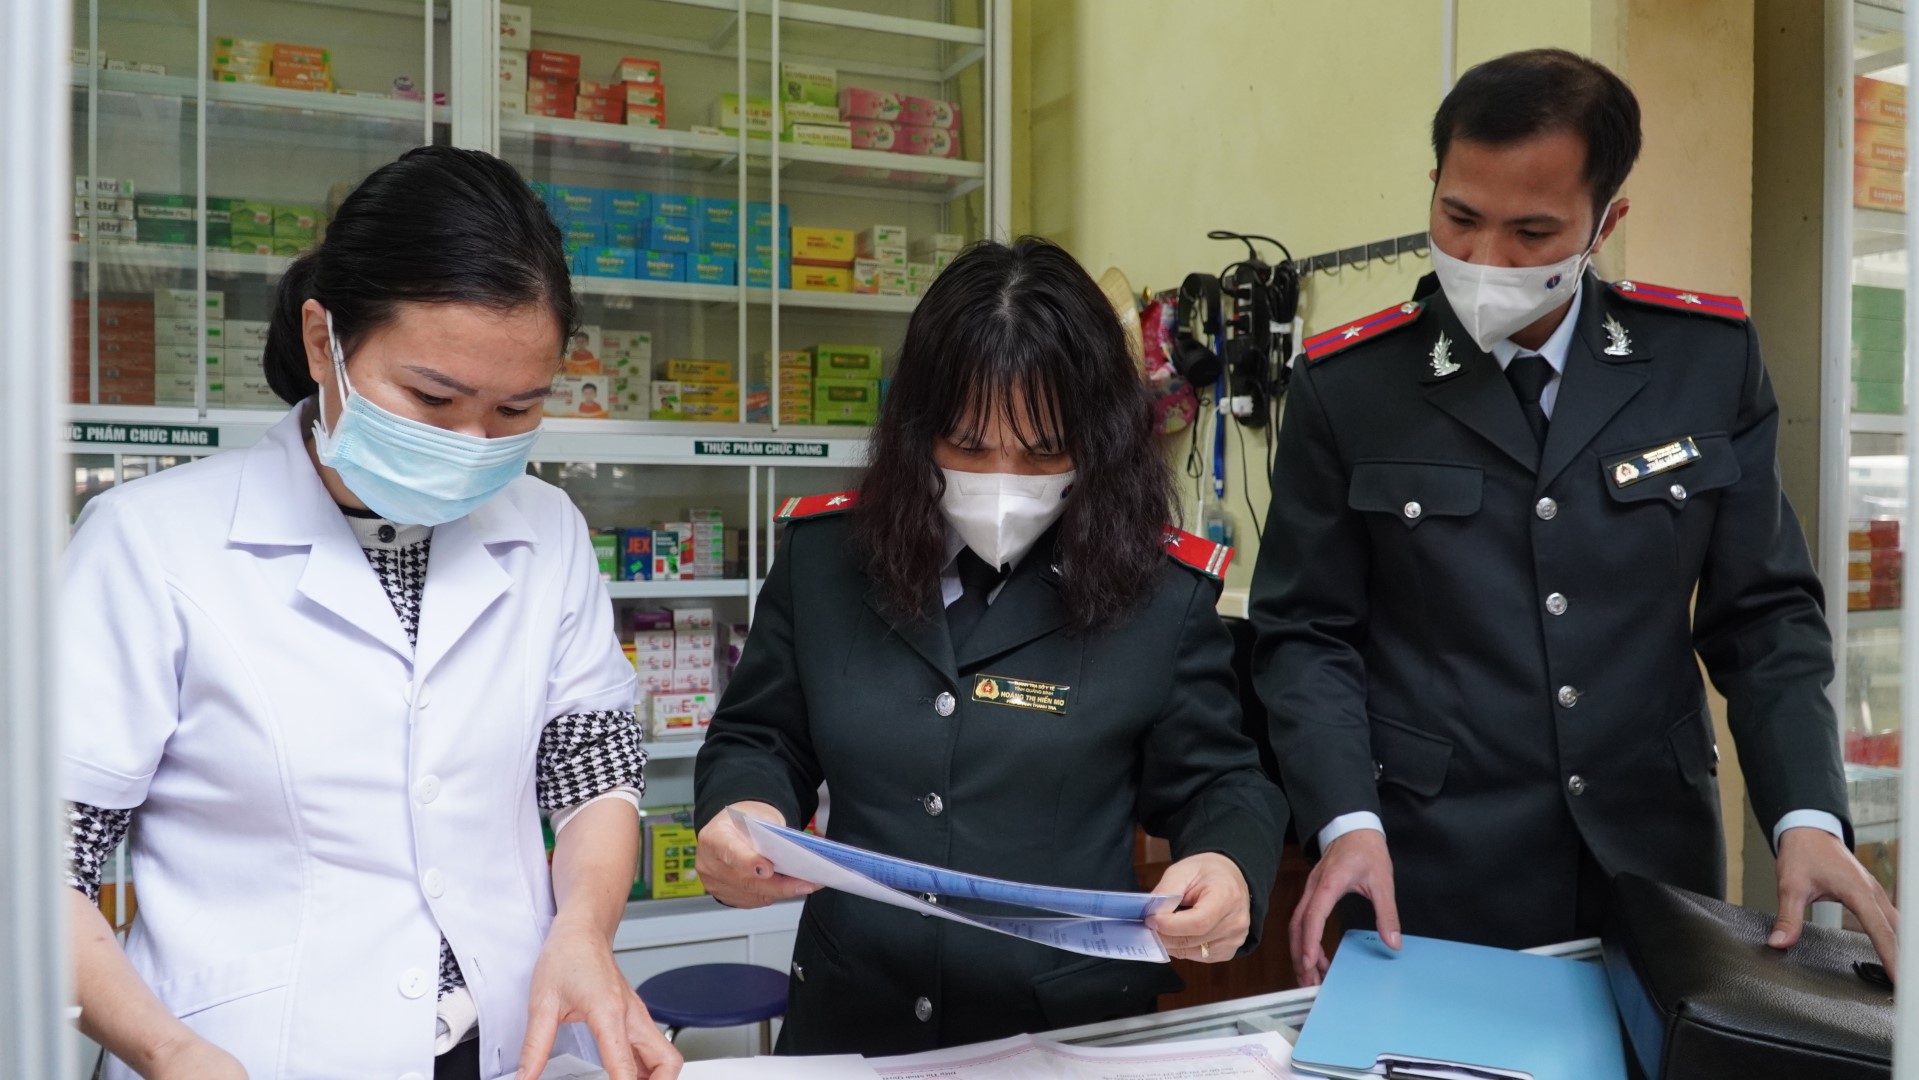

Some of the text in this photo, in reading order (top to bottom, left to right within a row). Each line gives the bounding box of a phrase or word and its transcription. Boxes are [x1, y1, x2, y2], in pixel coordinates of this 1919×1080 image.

[129, 429, 169, 443] CHỨC
[702, 442, 730, 455] THỰC
[764, 443, 793, 456] CHỨC
[627, 537, 651, 554] JEX
[1001, 691, 1024, 700] HOÀNG
[1026, 695, 1037, 703] THỊ
